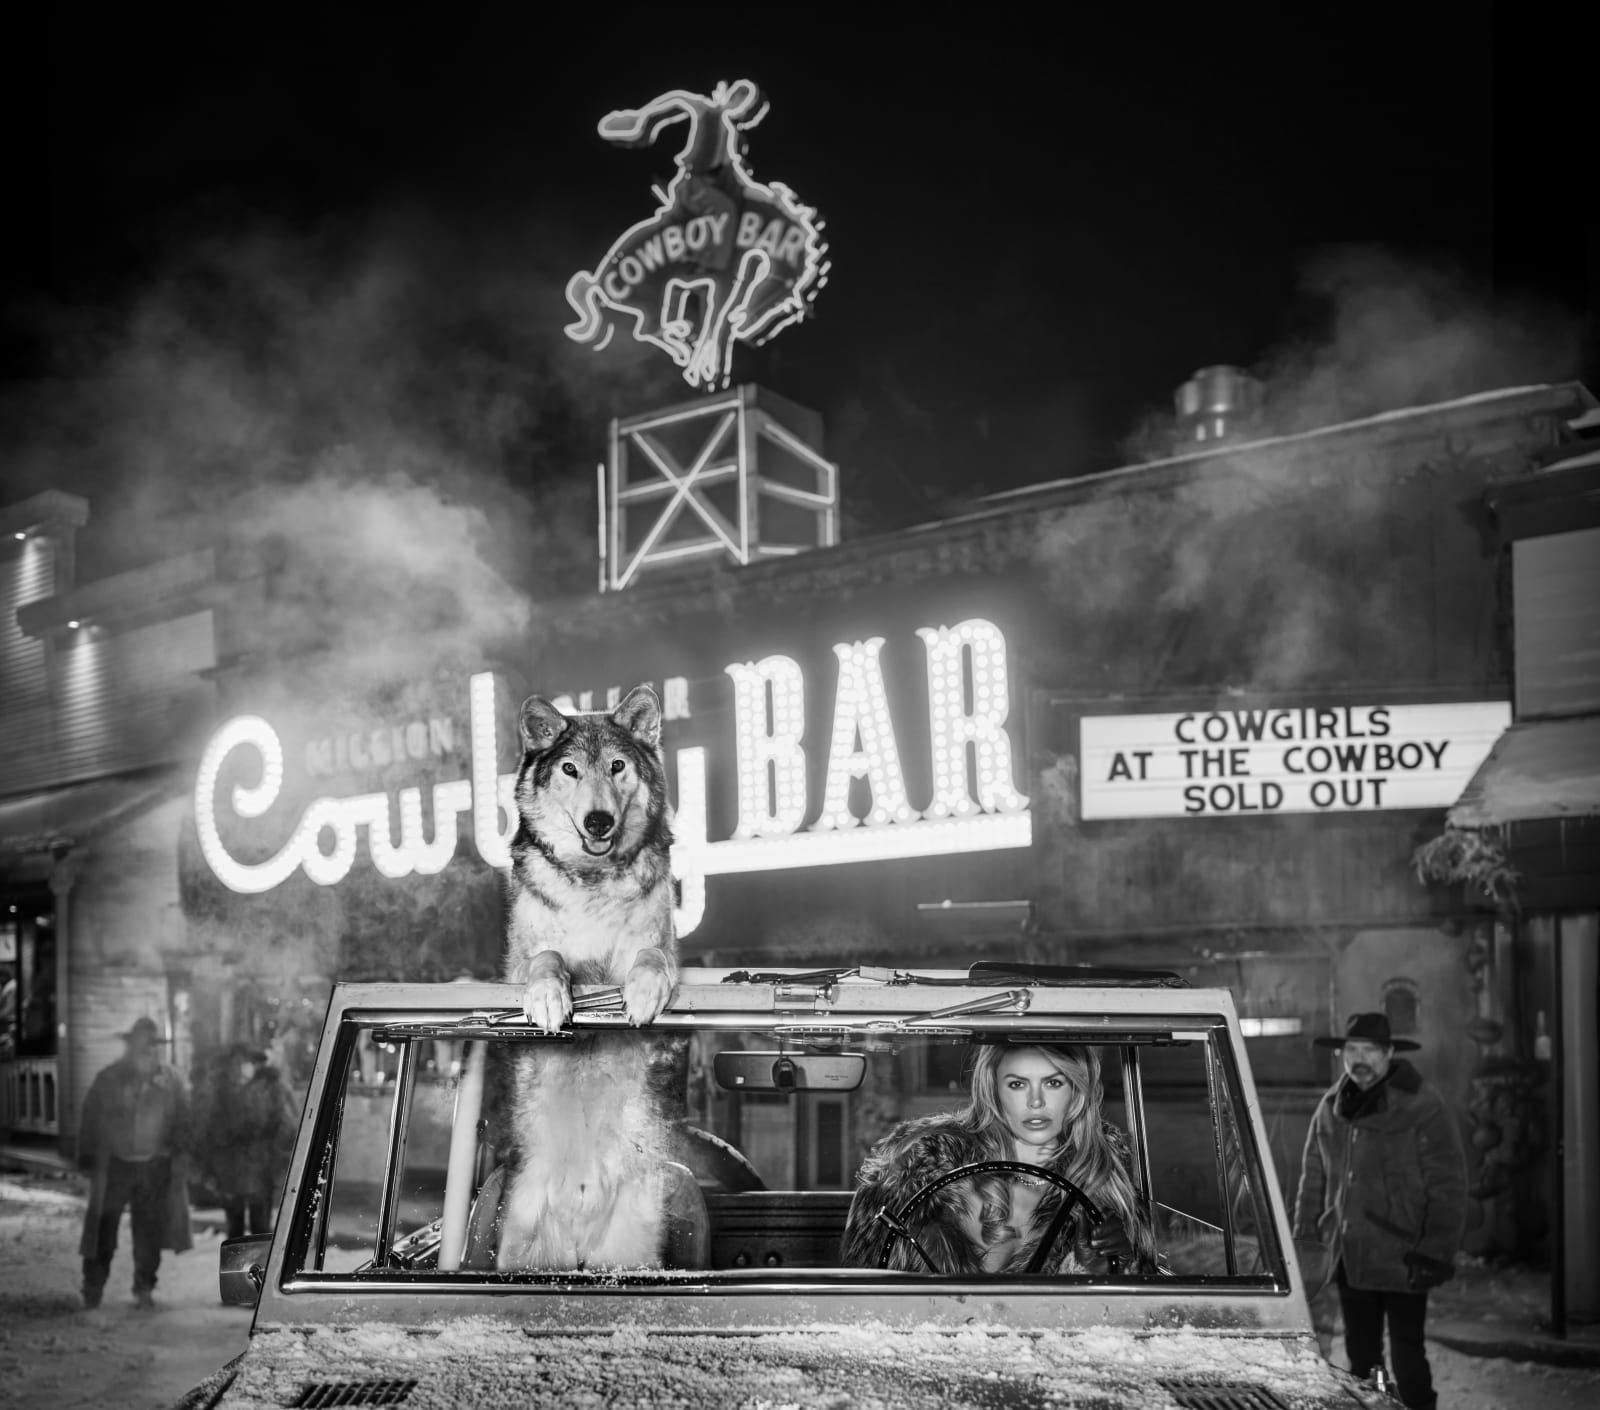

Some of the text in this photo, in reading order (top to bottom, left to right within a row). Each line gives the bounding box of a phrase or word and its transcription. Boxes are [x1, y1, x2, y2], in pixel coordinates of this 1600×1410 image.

[604, 212, 806, 300] COWBOY BAR
[1175, 706, 1391, 743] COWGIRLS
[196, 618, 1030, 939] Cowby BAR
[1107, 741, 1450, 782] AT THE COWBOY
[1184, 778, 1388, 814] SOLD OUT
